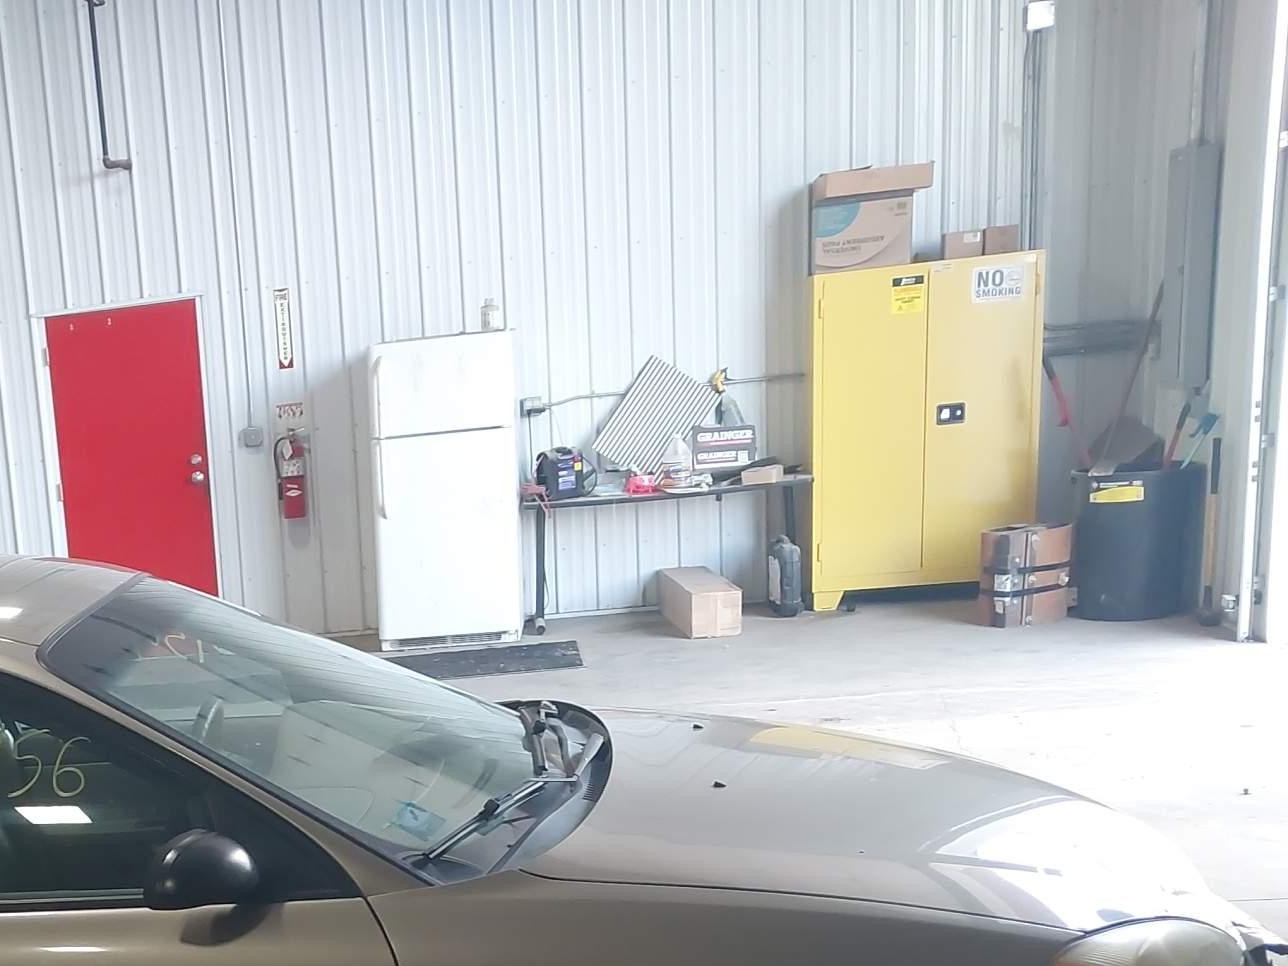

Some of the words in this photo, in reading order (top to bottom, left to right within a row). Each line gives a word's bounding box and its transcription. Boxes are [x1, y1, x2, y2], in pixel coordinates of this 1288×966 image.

[977, 270, 1004, 288] NO
[975, 286, 1021, 298] SMOKING
[697, 430, 754, 442] GRAINGER
